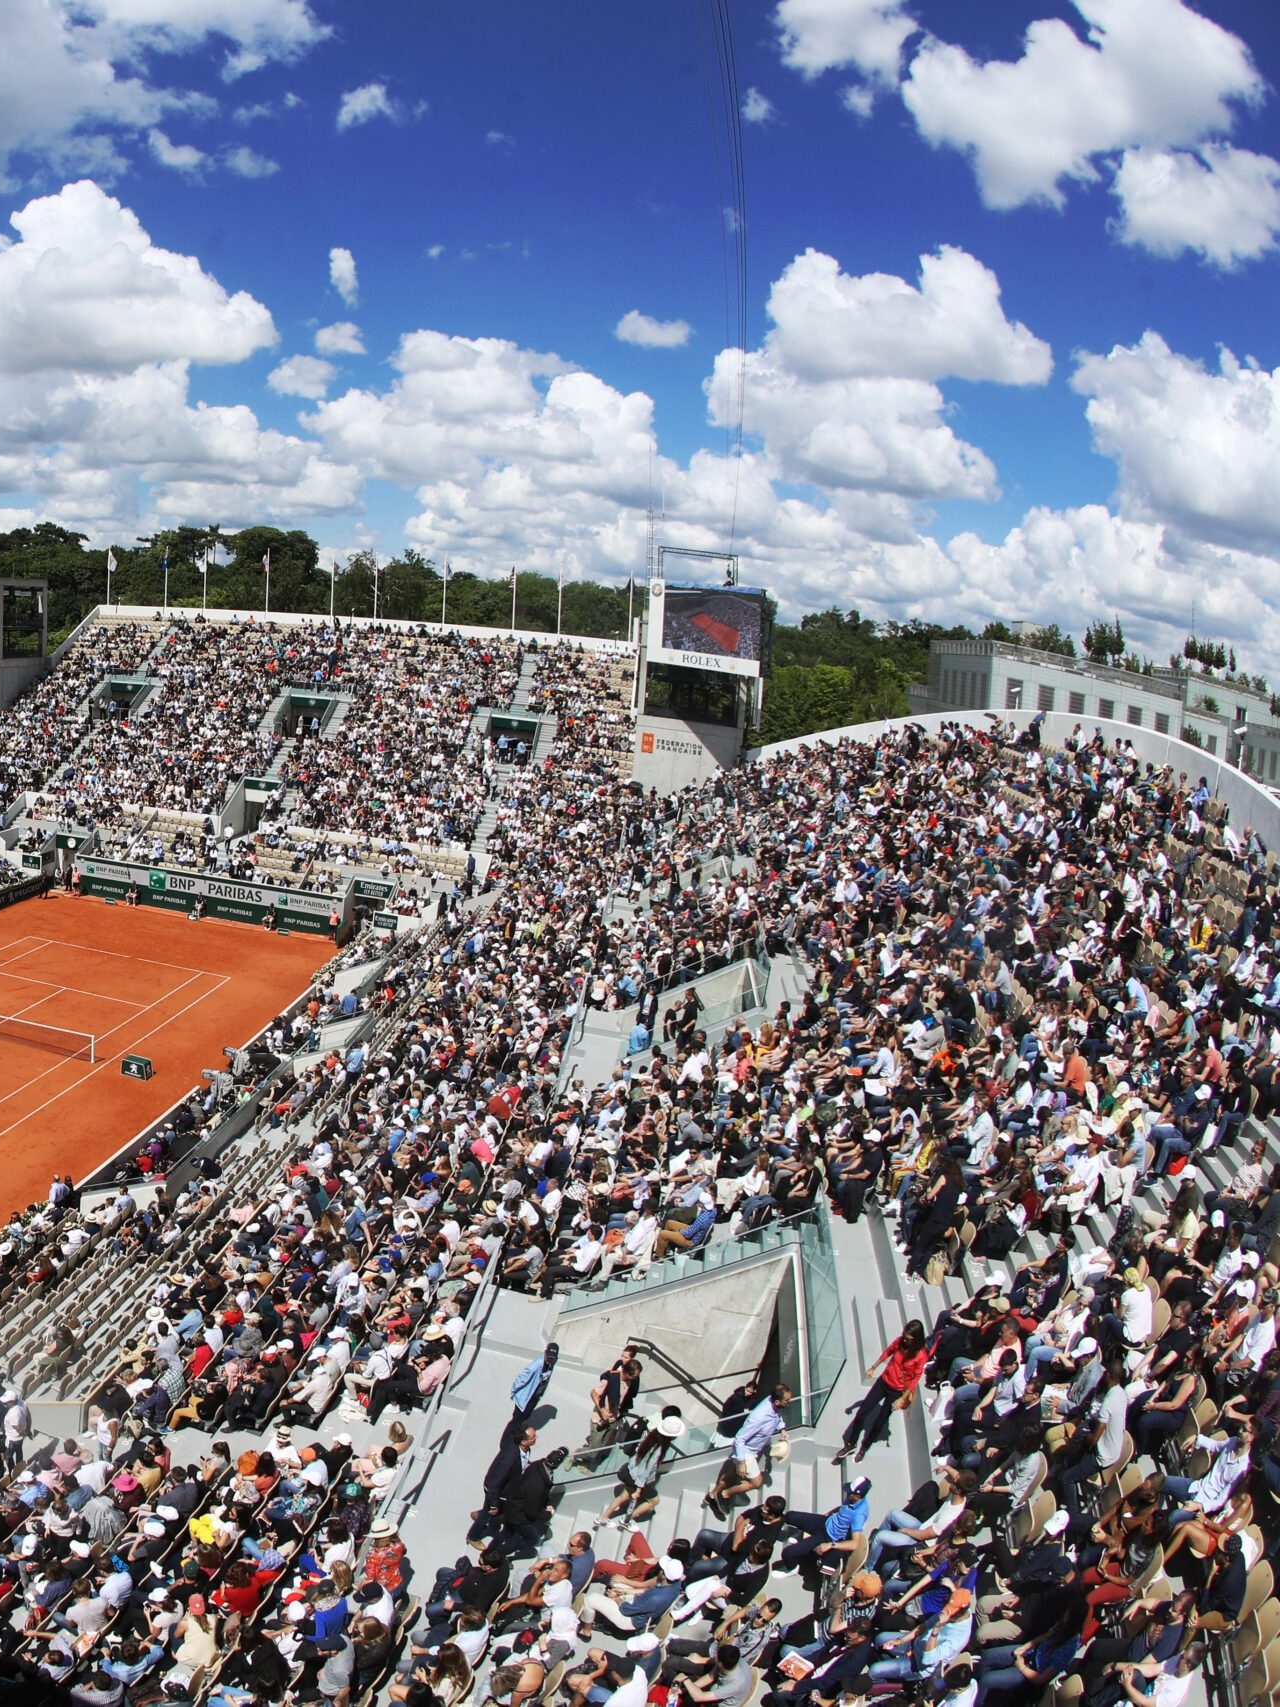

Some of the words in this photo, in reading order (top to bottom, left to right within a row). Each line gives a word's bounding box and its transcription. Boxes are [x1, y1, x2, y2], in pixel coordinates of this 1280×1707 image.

[682, 653, 721, 669] ROLEX
[103, 886, 124, 894] PARIBAS
[169, 876, 196, 891] BNP
[207, 883, 263, 903] PARIBAS
[360, 881, 388, 892] Emirates
[164, 896, 186, 905] PARIBAS
[303, 900, 331, 910] PARIBAS
[229, 907, 253, 917] PARIBAS
[295, 919, 321, 928] PARIBAS
